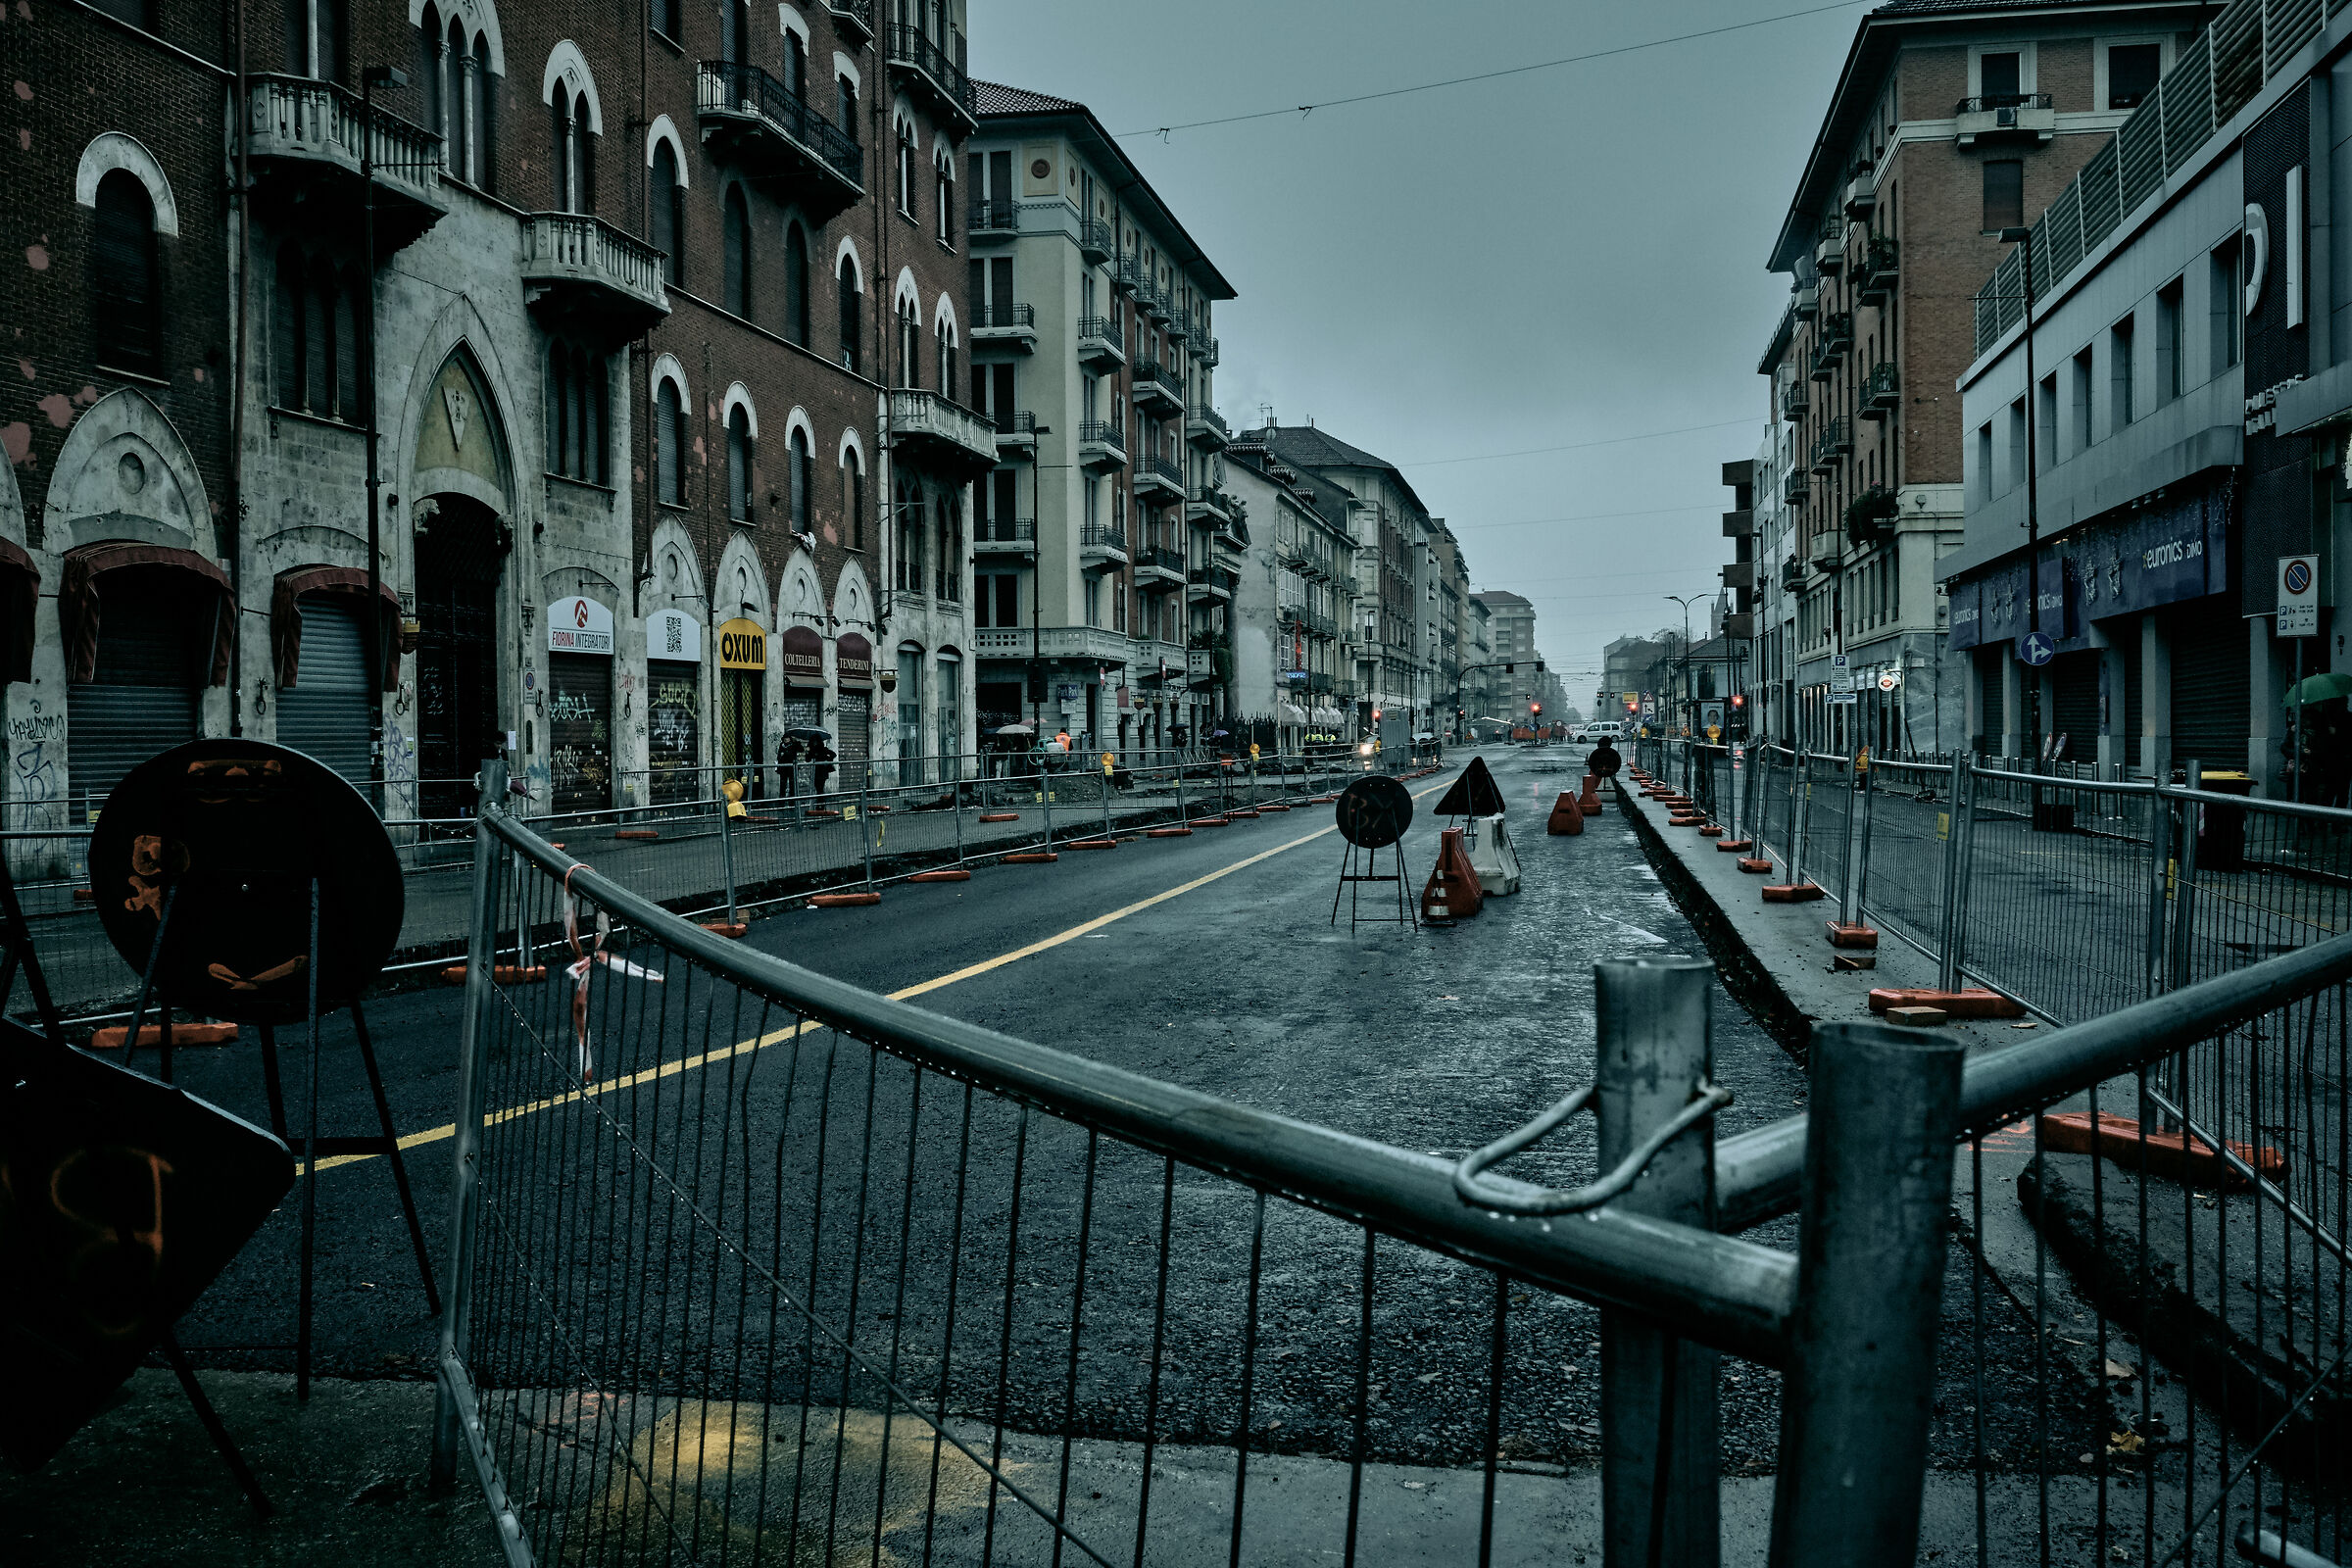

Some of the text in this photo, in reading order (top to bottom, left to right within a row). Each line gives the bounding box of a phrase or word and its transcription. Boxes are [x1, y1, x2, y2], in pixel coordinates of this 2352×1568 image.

[2146, 535, 2183, 569] euronics
[552, 631, 611, 650] FIORINA INTEGRATORI
[721, 632, 763, 663] OXUM
[784, 653, 821, 667] COLTELLERIA
[839, 657, 870, 671] TENDERINI
